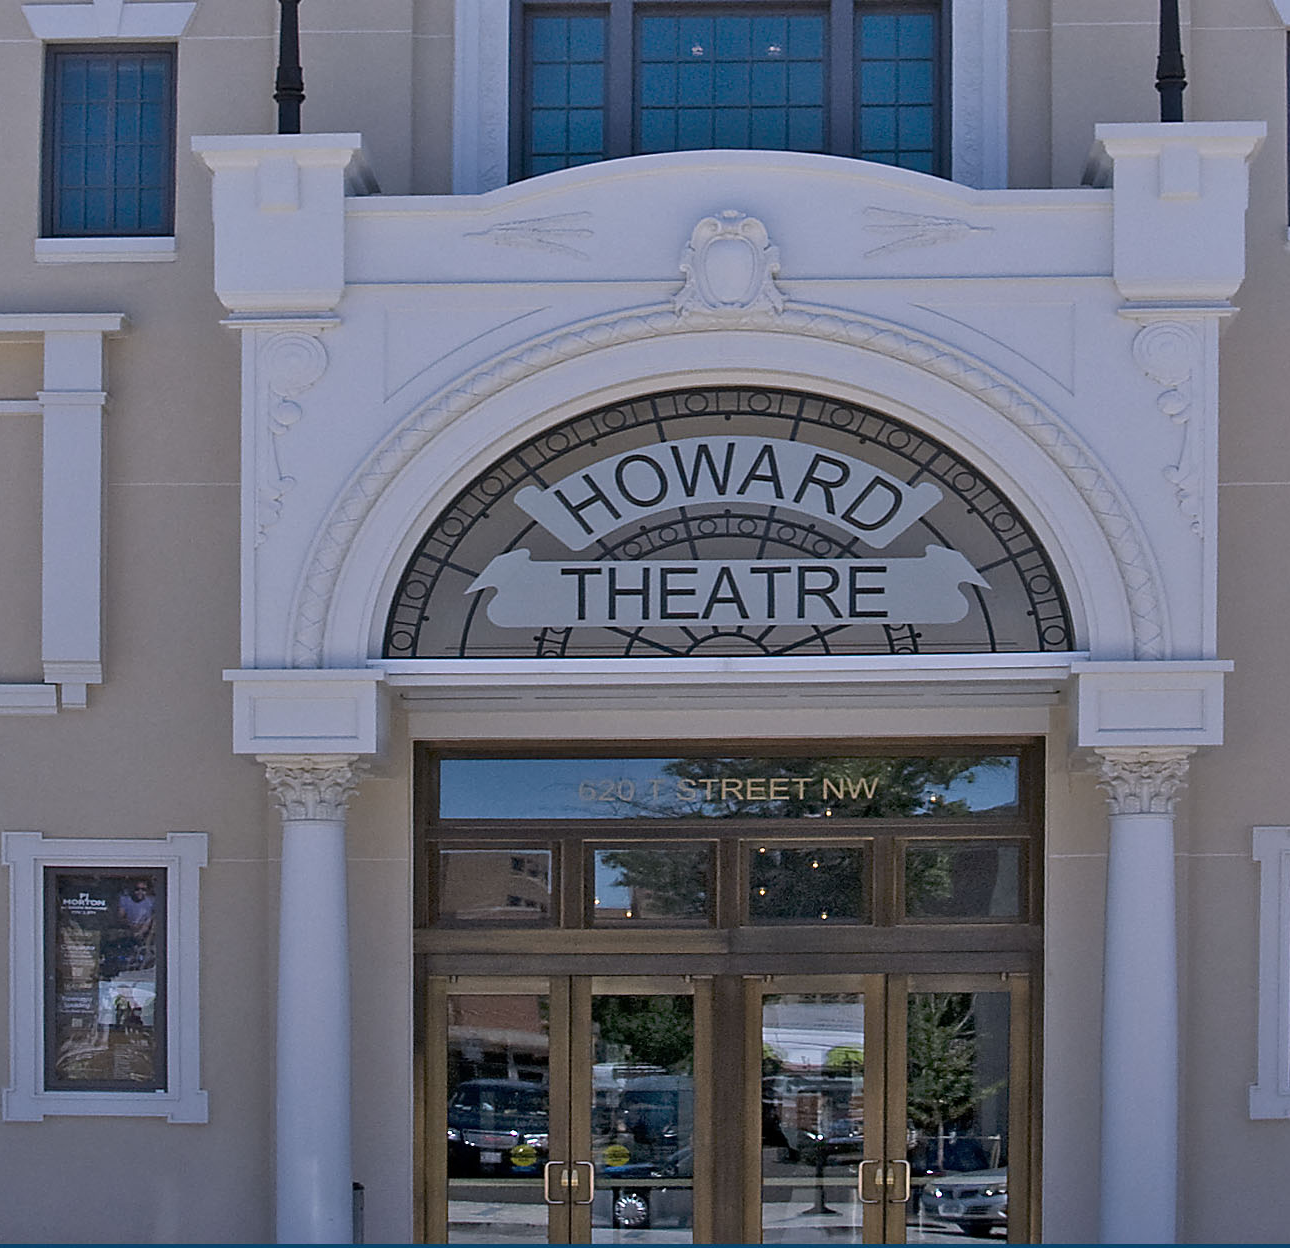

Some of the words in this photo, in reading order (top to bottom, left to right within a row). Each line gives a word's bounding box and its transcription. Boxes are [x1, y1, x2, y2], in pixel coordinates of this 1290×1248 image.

[553, 442, 903, 535] HOWARD
[561, 566, 888, 620] THEATRE
[578, 779, 635, 800] 620
[647, 779, 666, 800] T
[676, 778, 813, 800] STREET
[822, 777, 879, 800] NW
